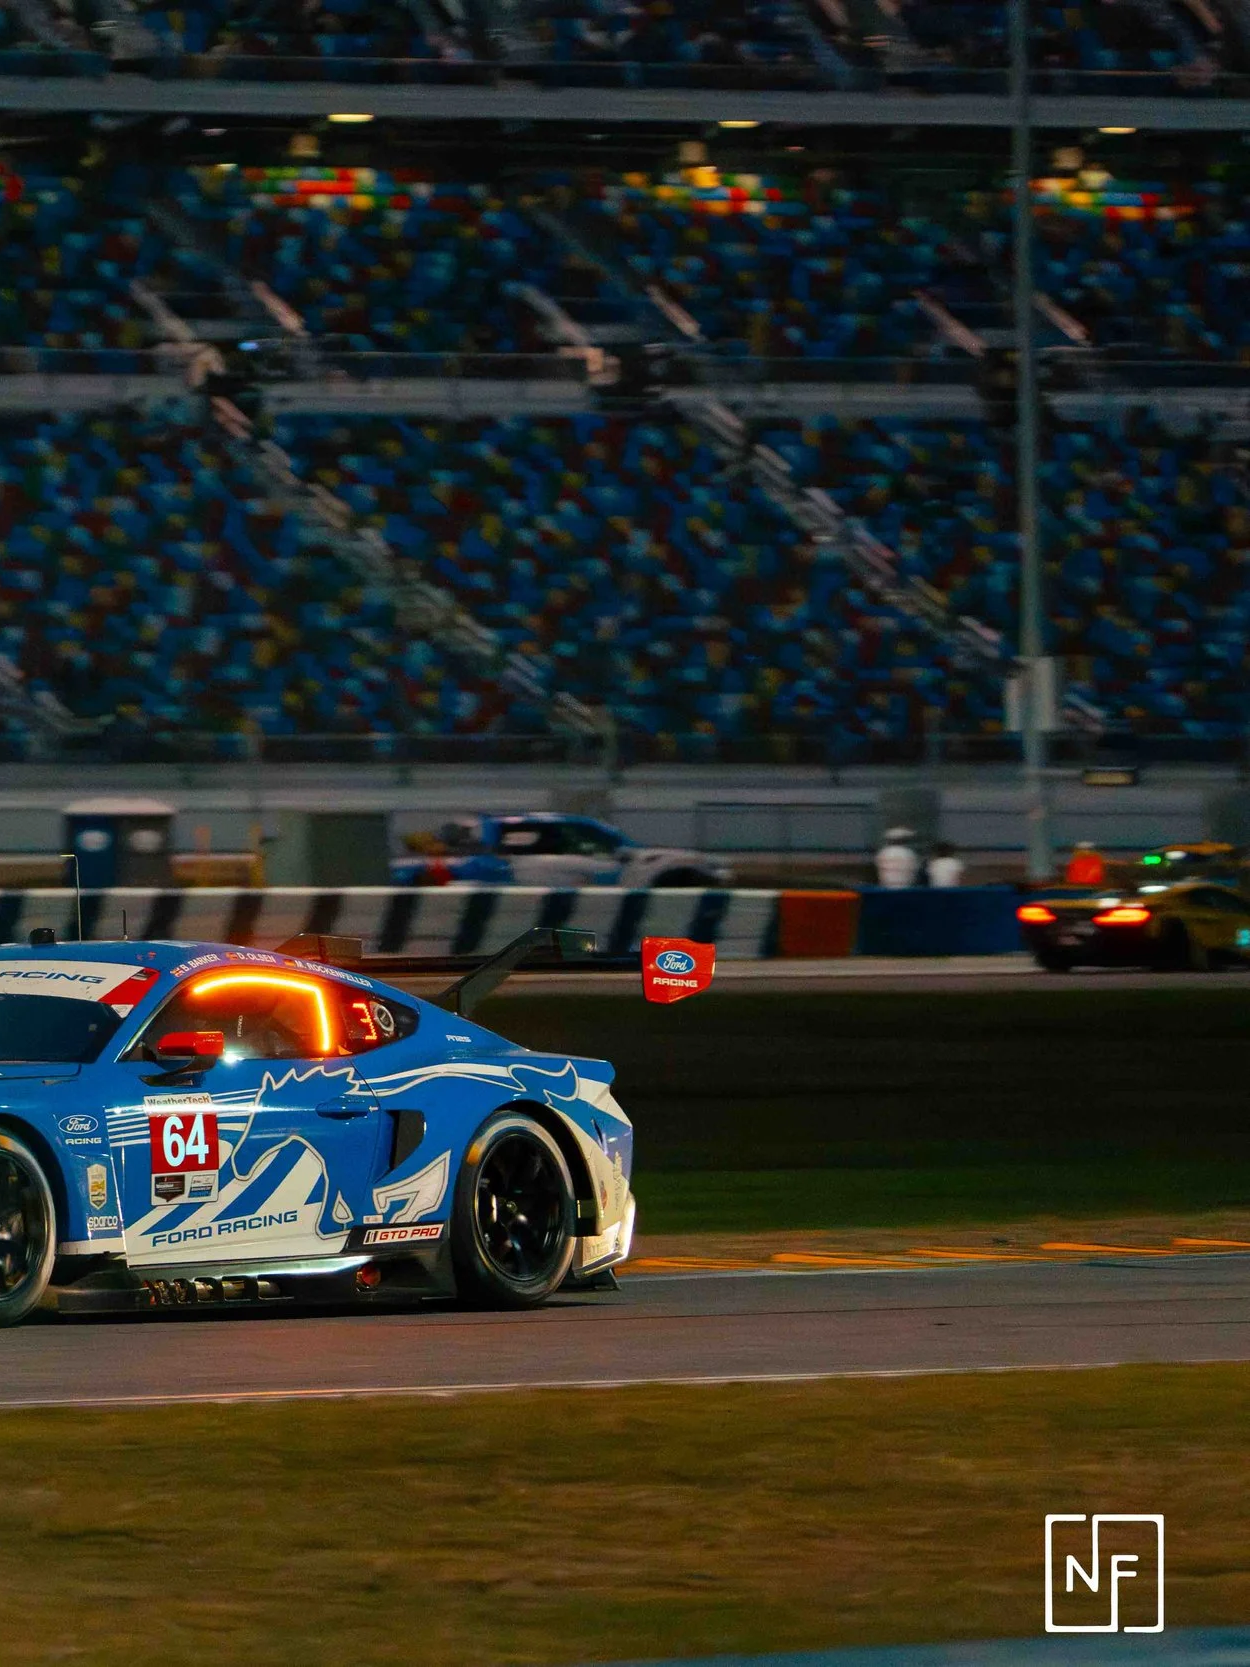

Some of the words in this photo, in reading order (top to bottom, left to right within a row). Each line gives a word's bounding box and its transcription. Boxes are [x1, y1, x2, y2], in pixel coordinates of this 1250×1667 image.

[188, 953, 221, 969] BARKER
[248, 952, 277, 964] OLSEN
[662, 952, 688, 971] Ford
[306, 962, 374, 989] ROCKENFELLER
[652, 976, 699, 989] RACING
[146, 1094, 211, 1106] WeatherTech
[65, 1117, 92, 1132] Ford
[162, 1112, 210, 1168] 64
[88, 1215, 119, 1230] sparco
[151, 1224, 213, 1248] FORD
[216, 1210, 298, 1236] RACING
[379, 1229, 408, 1241] GTD
[410, 1227, 440, 1238] PRO
